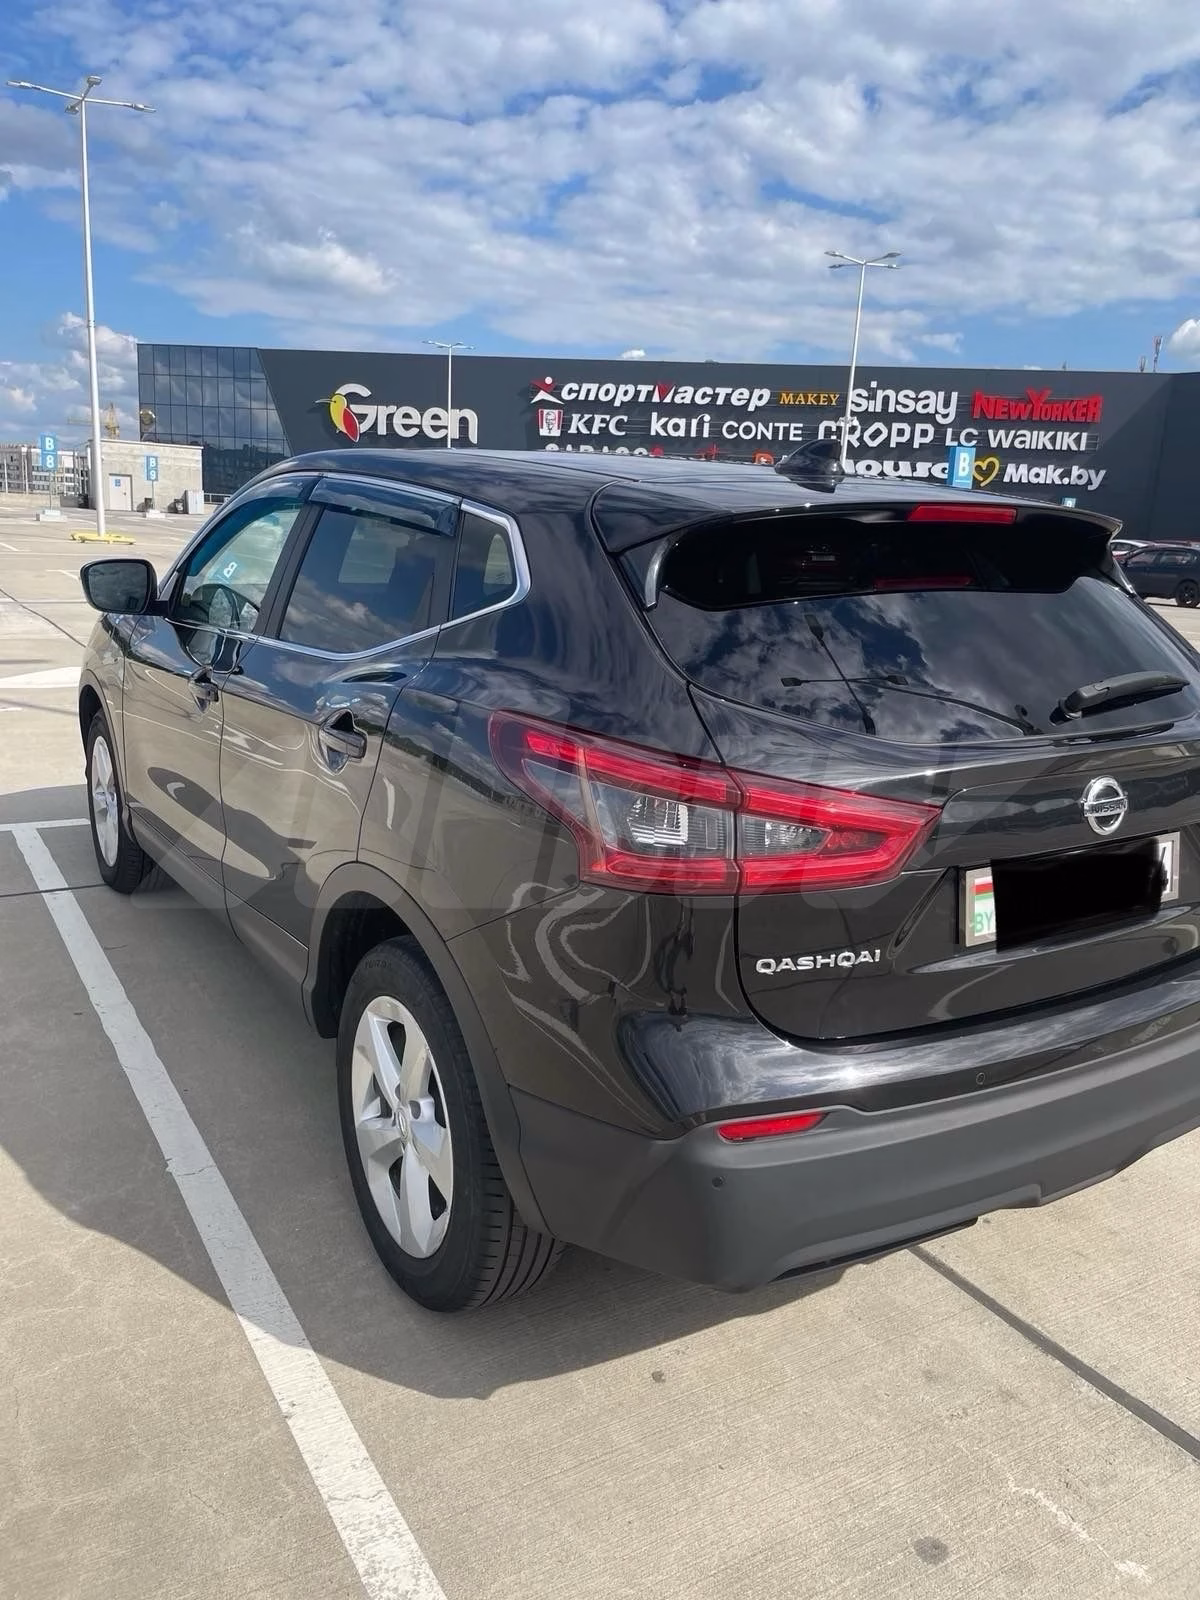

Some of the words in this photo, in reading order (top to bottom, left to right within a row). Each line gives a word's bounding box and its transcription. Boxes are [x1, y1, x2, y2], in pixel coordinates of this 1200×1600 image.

[779, 392, 840, 406] MAKEY
[850, 380, 958, 425] sinsay
[333, 383, 478, 444] Green
[567, 413, 629, 436] KFC
[650, 412, 711, 438] kari
[45, 436, 55, 450] B
[721, 420, 804, 441] CONTE
[817, 419, 935, 449] CROPP
[945, 427, 979, 447] LC
[45, 454, 55, 469] 8
[958, 452, 970, 477] B
[1003, 463, 1107, 491] Mak.by
[755, 949, 880, 975] QASHQAI
